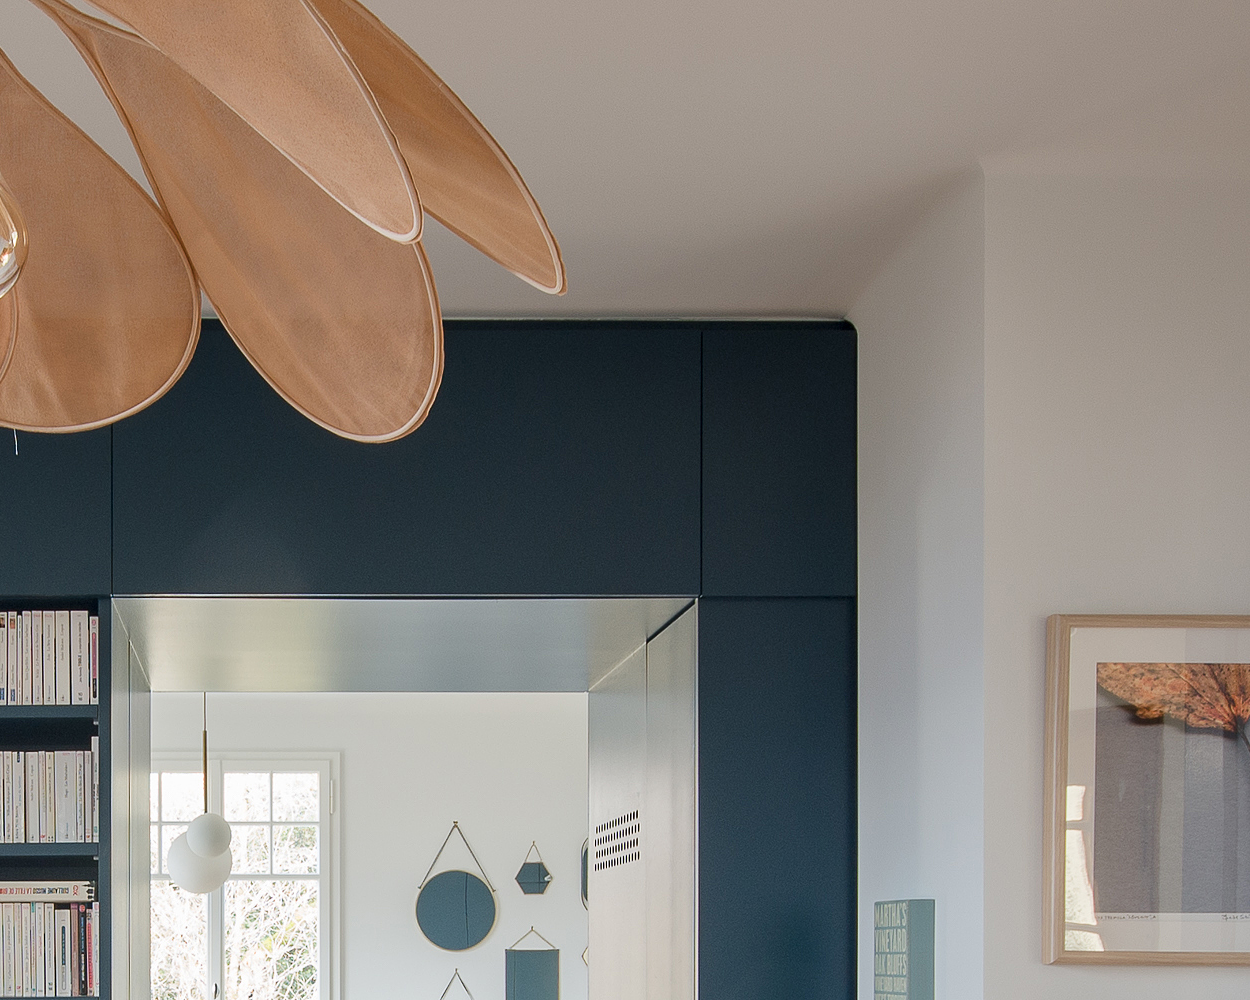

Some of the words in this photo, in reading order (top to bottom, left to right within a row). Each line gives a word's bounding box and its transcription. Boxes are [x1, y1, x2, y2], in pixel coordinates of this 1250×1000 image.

[875, 902, 908, 928] MARTHA'S
[875, 928, 908, 953] VINEYARD
[875, 953, 886, 976] OAK
[887, 953, 908, 977] BLUFFS
